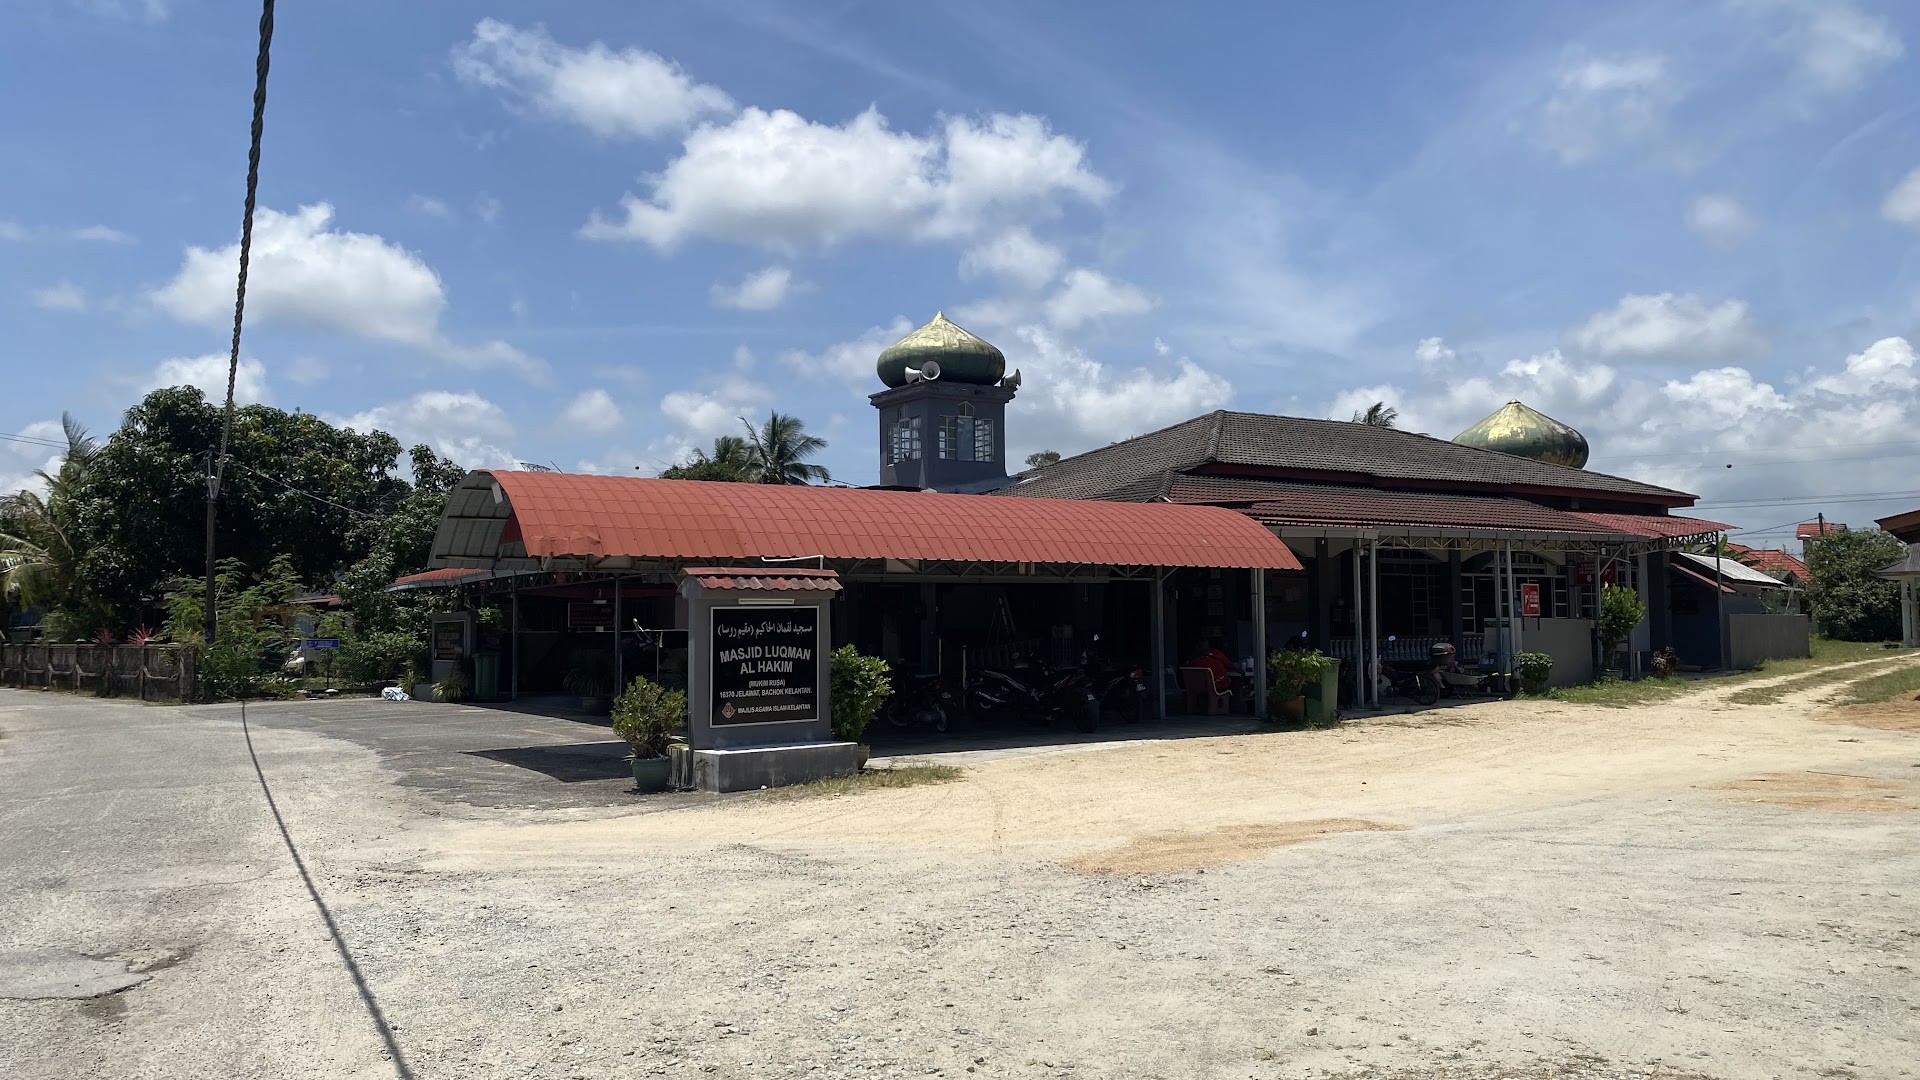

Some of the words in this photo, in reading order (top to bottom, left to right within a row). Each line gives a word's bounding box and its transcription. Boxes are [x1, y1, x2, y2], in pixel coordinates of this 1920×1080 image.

[776, 621, 792, 634] لقمان
[719, 646, 762, 664] MASJID
[765, 646, 811, 661] LUQMAN
[740, 661, 756, 674] AL
[758, 660, 793, 673] HAKIM
[748, 680, 769, 689] (MUKIM
[769, 679, 786, 687] RUSA)
[735, 689, 761, 698] JELAWAT,
[761, 688, 785, 696] BACHOK
[784, 687, 812, 695] KELANTAN.
[737, 706, 756, 714] MAJLIS
[756, 705, 773, 713] AGAMA
[772, 704, 787, 712] ISLAM
[787, 703, 811, 711] KELANTAN
